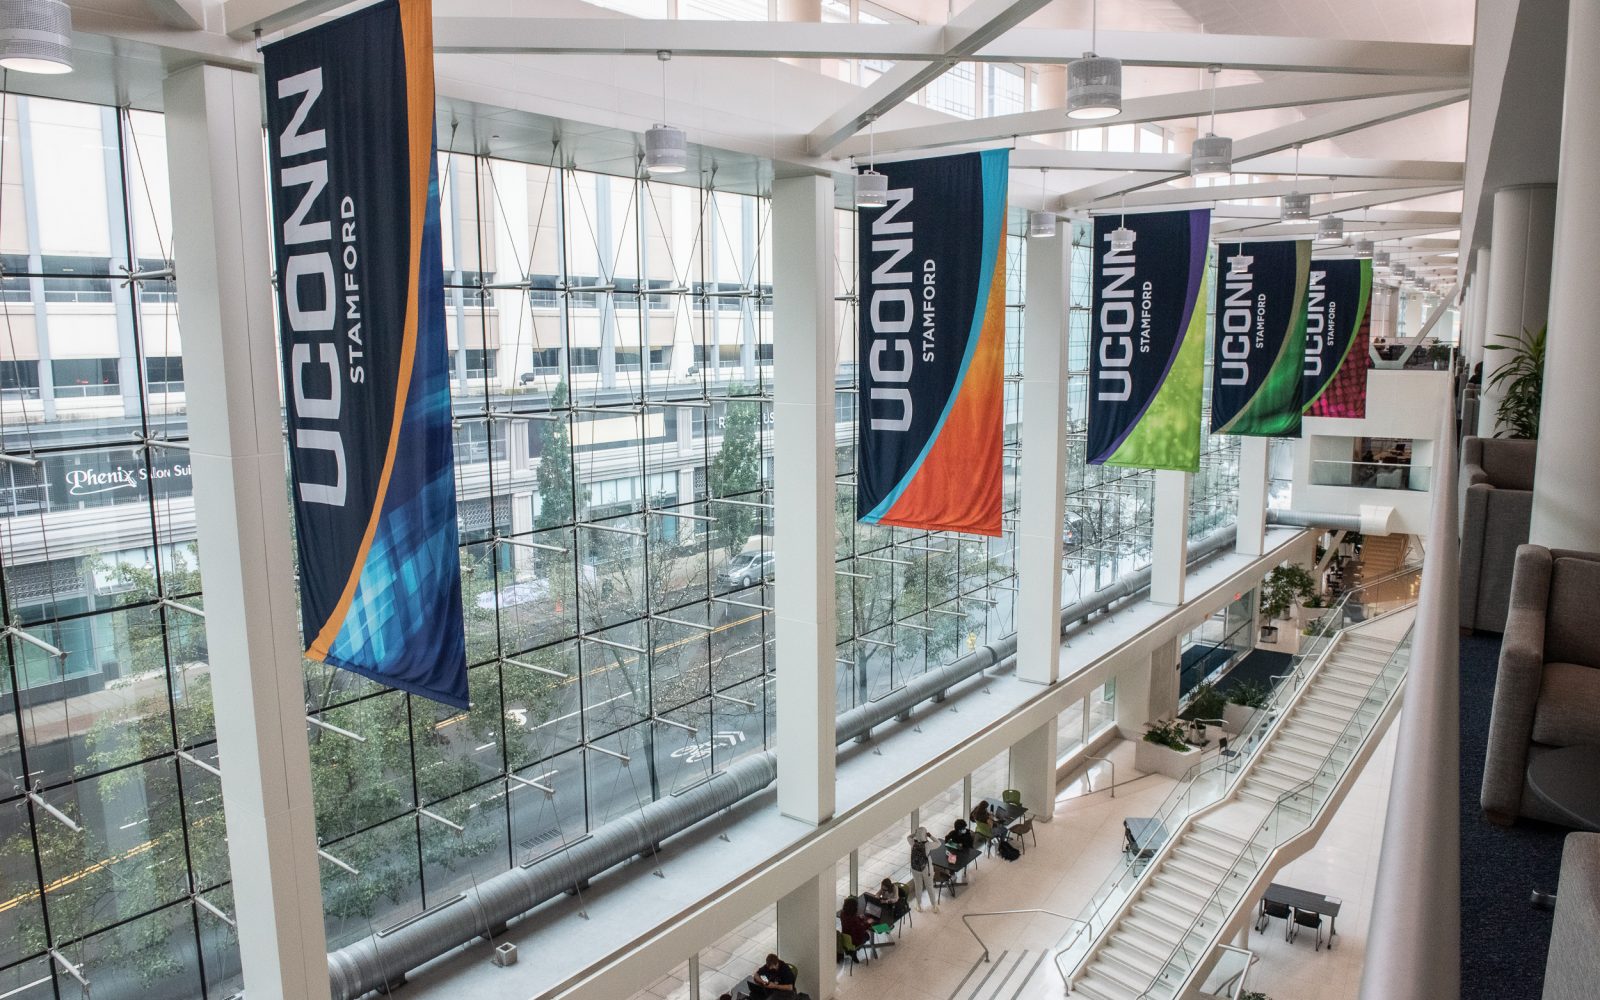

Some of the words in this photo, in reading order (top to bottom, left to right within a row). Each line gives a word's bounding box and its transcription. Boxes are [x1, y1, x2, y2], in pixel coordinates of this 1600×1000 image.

[278, 66, 347, 507] UCONN
[340, 195, 365, 384] STAMFORD
[869, 187, 914, 432] UCONN
[923, 258, 936, 363] STAMFORD
[1140, 281, 1152, 353] STAMFORD
[1256, 293, 1267, 349] STAMFORD
[1327, 301, 1337, 346] STAMFORD
[65, 466, 137, 495] Phenix
[139, 467, 171, 480] Slon
